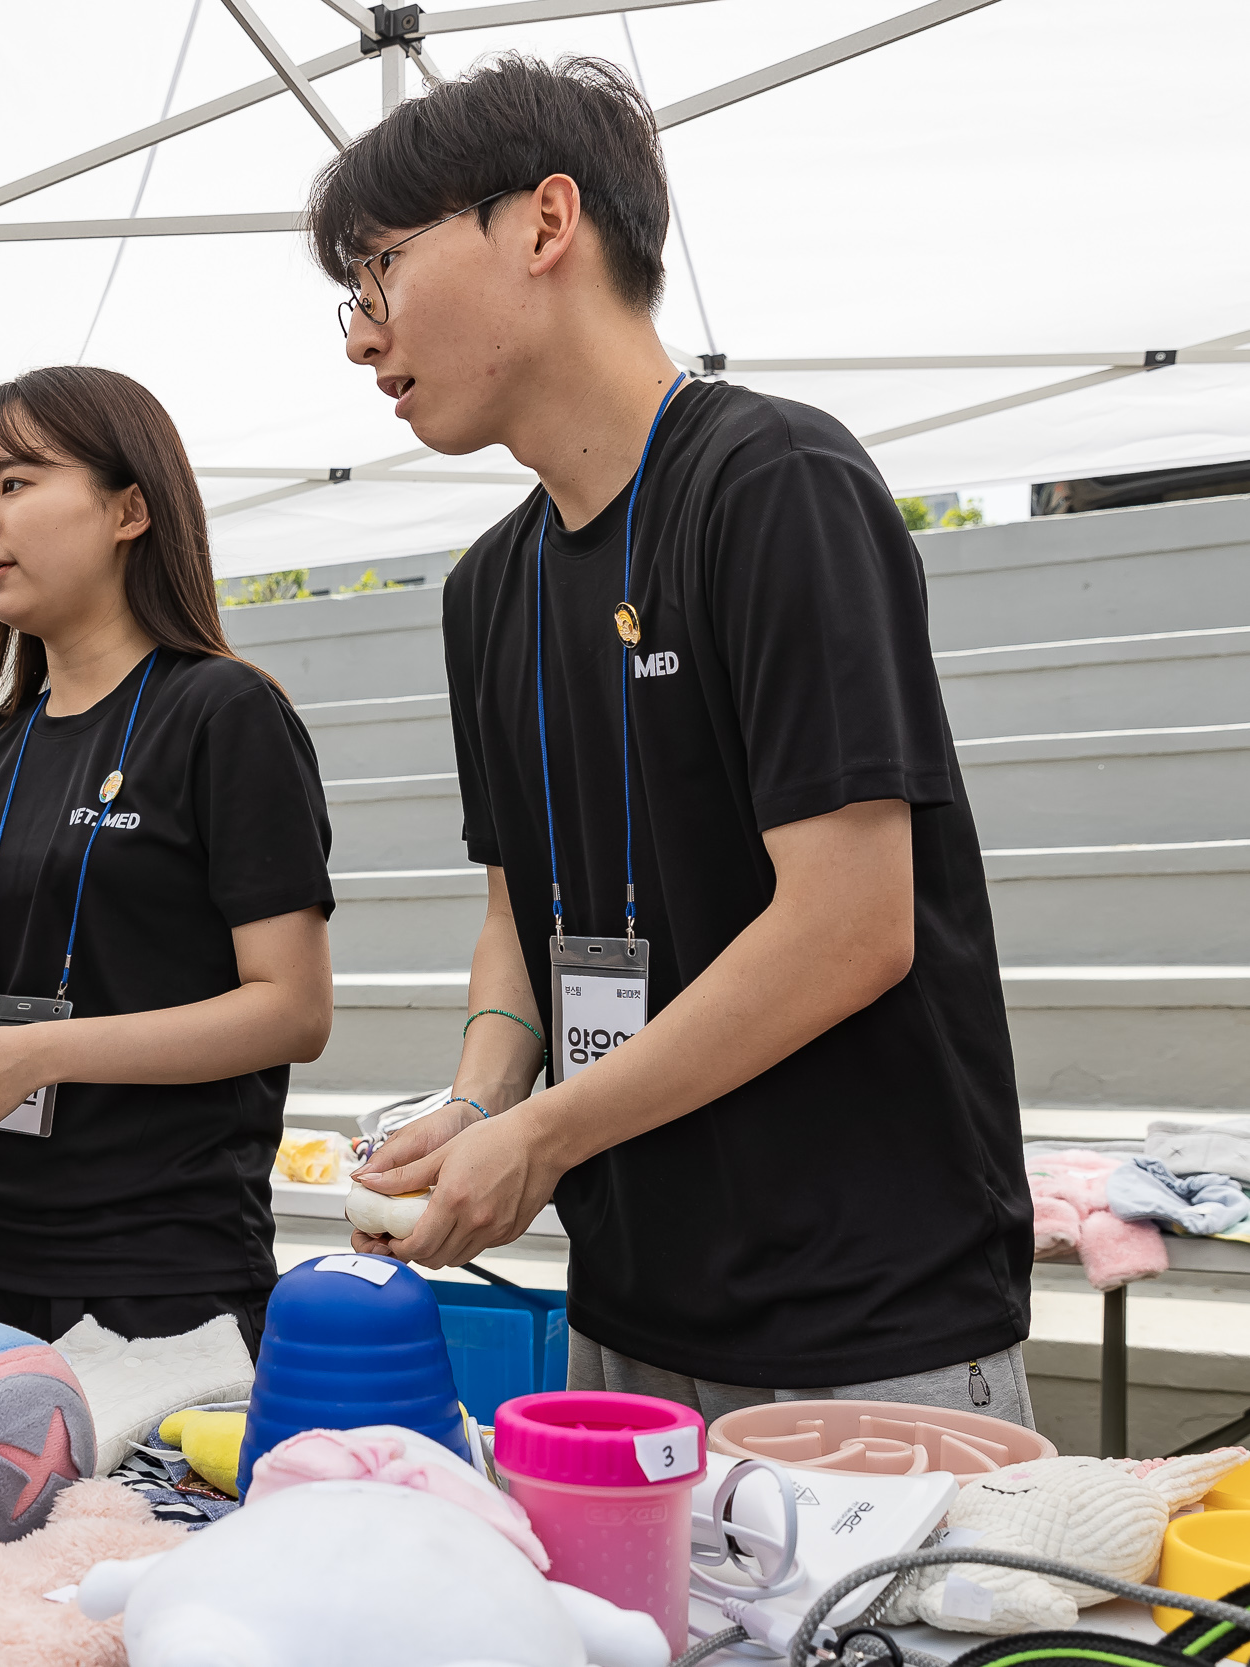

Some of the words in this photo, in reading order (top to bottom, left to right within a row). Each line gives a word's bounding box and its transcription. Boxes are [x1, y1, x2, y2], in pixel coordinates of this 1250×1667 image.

[634, 651, 680, 679] MED
[565, 985, 582, 997] 부스팅
[662, 1445, 675, 1468] 3
